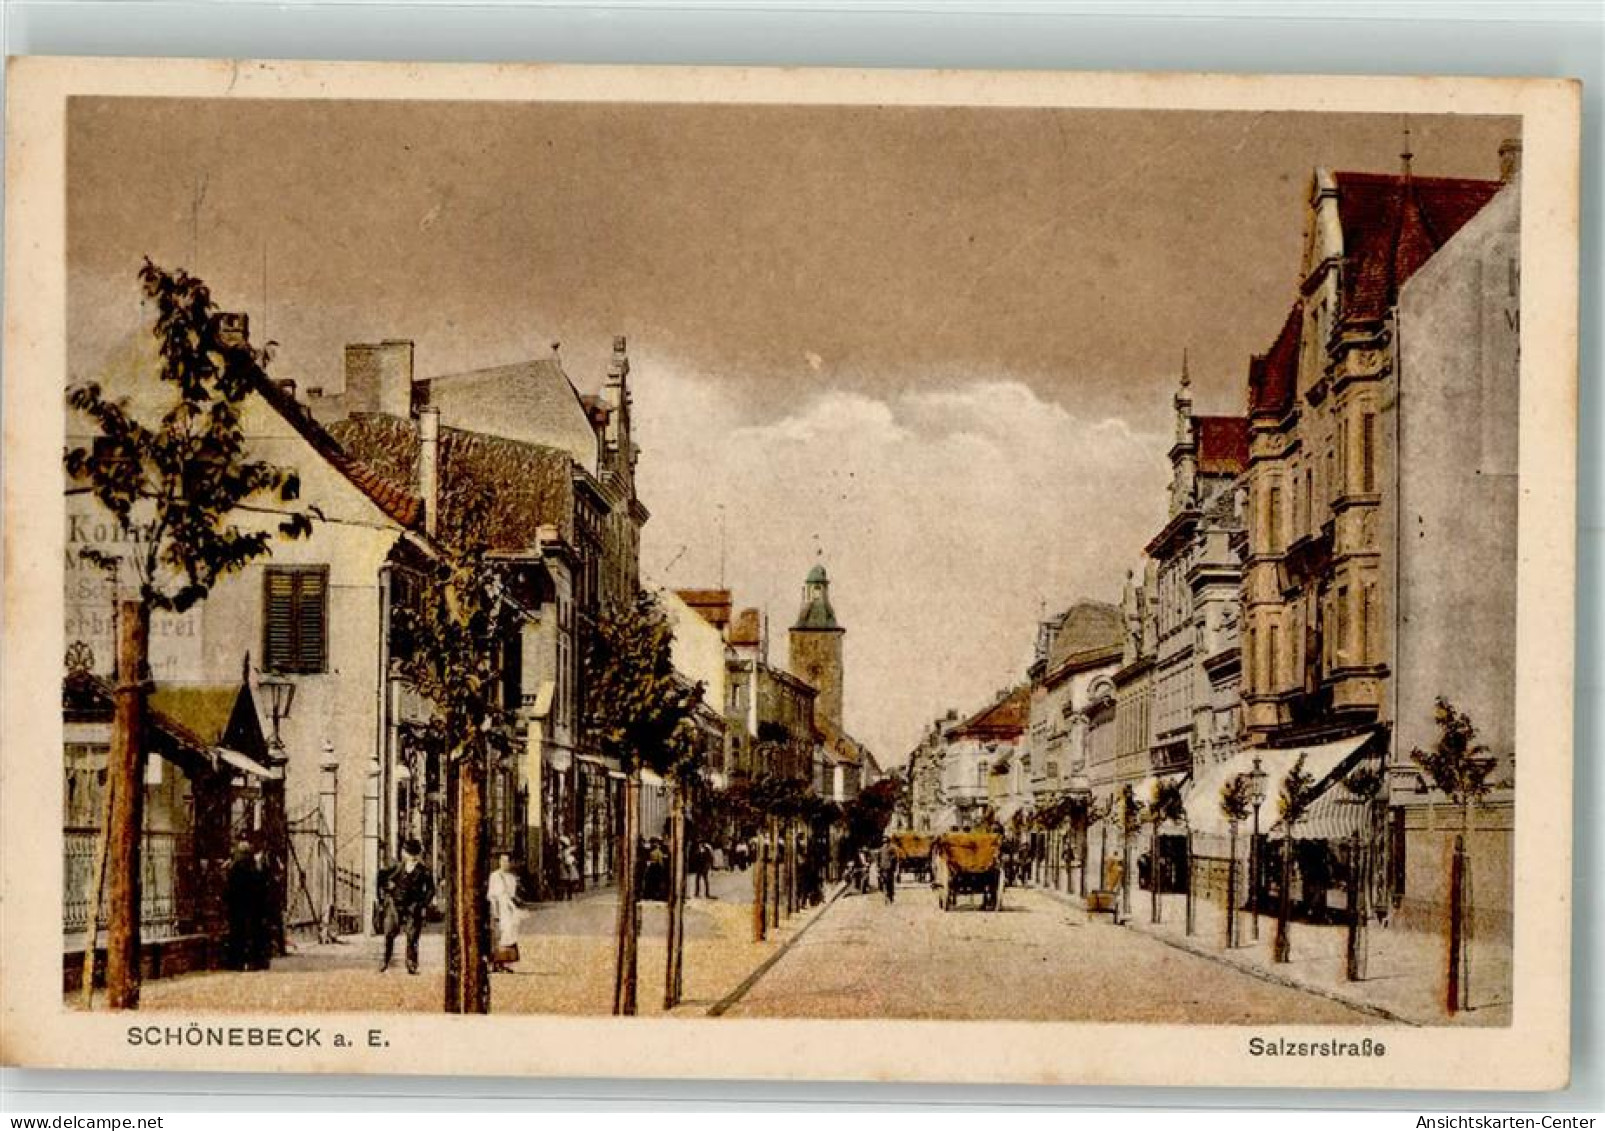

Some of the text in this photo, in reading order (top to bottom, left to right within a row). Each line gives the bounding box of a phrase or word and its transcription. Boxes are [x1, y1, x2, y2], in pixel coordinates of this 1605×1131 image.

[127, 1022, 390, 1048] SCHÖNEBECK a. E.
